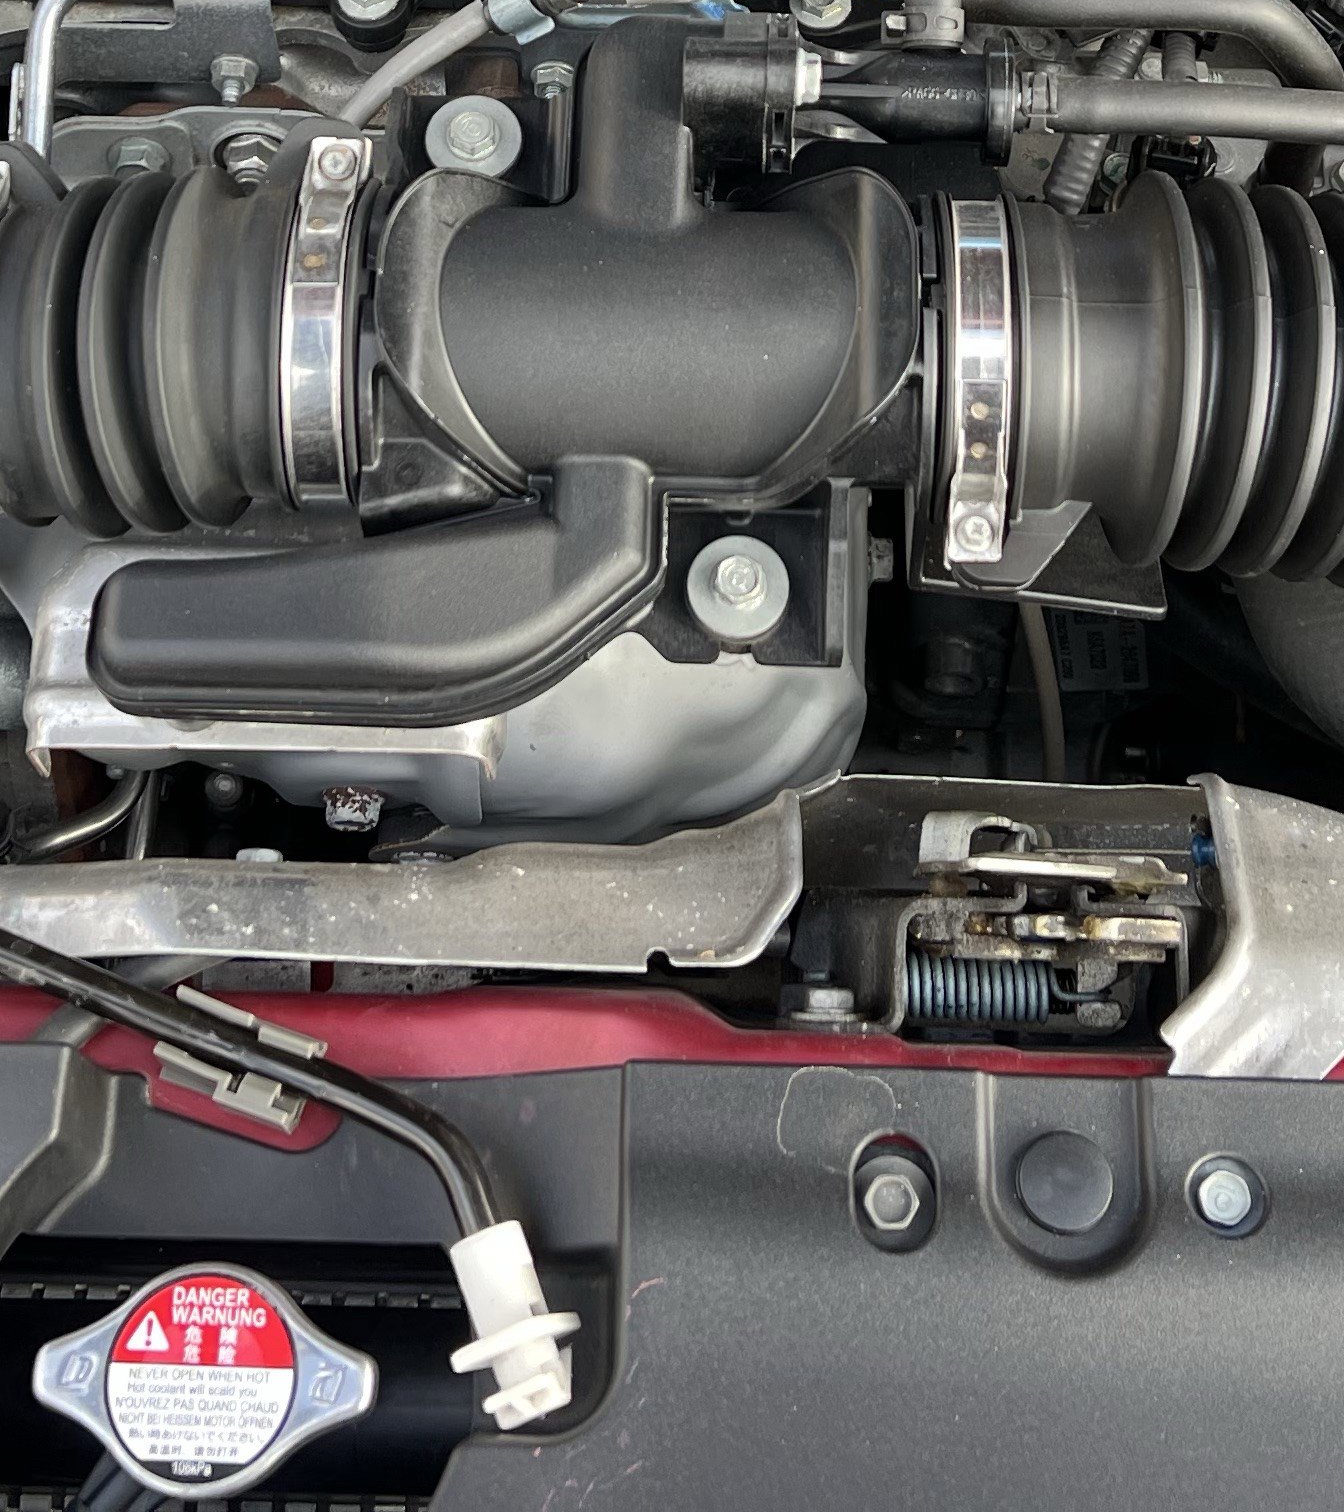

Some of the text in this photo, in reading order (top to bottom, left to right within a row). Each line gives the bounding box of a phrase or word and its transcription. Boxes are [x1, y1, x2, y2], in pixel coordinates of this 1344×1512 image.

[172, 1286, 249, 1307] DANGER
[172, 1306, 267, 1328] WARNUNG
[128, 1368, 270, 1383] NEVER OPEN WHEN HOT
[127, 1383, 257, 1398] Hot coolant will scald you
[115, 1396, 279, 1414] N'OUVREZ PAS QUAND CHAUD
[119, 1412, 145, 1424] NICHT
[203, 1415, 236, 1428] MOTOR
